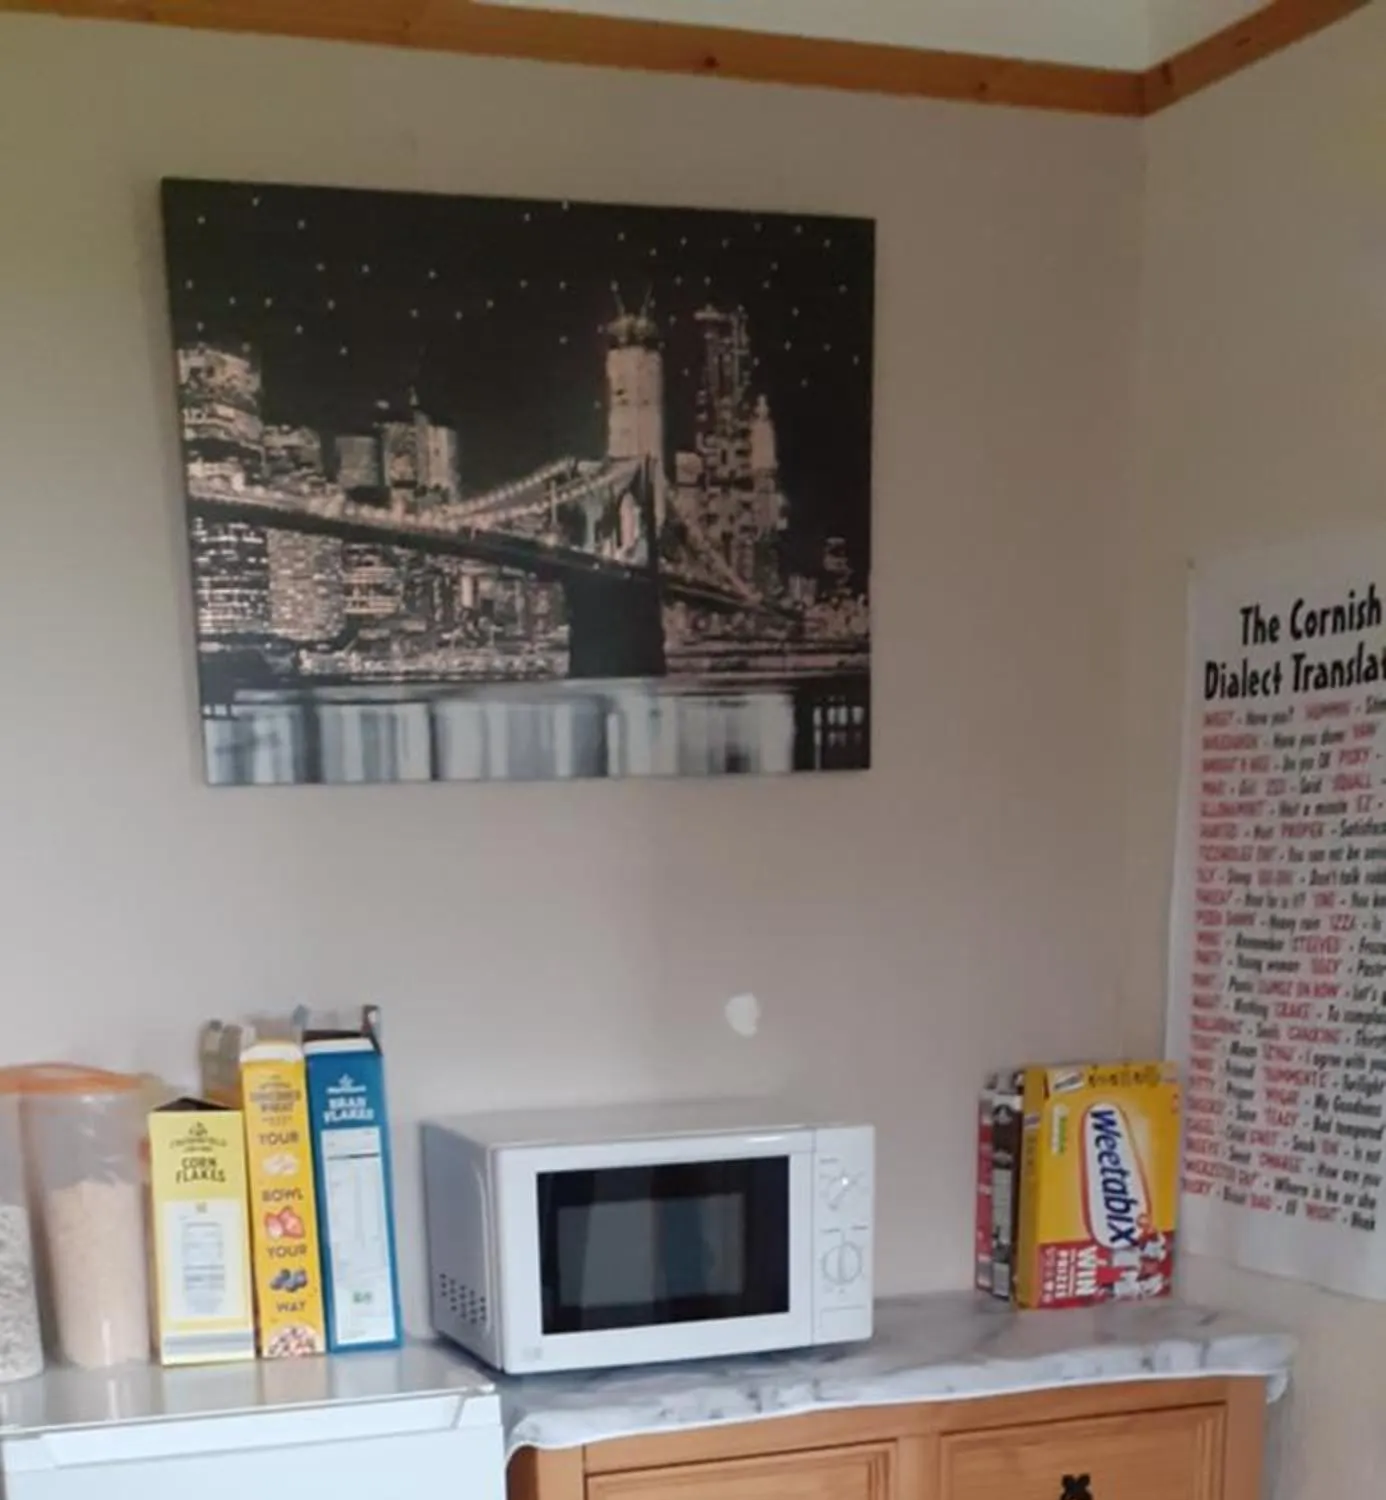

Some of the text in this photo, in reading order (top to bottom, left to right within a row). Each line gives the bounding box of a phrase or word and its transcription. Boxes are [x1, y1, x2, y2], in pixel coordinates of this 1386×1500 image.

[1240, 582, 1382, 646] The Cornish
[1204, 657, 1282, 700] Dialect
[258, 1132, 299, 1145] YOUR
[181, 1156, 217, 1170] CORN
[175, 1166, 227, 1184] FLAKES
[262, 1190, 304, 1202] BOWL
[266, 1245, 307, 1259] YOUR
[1076, 1246, 1099, 1296] WIN
[276, 1302, 305, 1313] WAY
